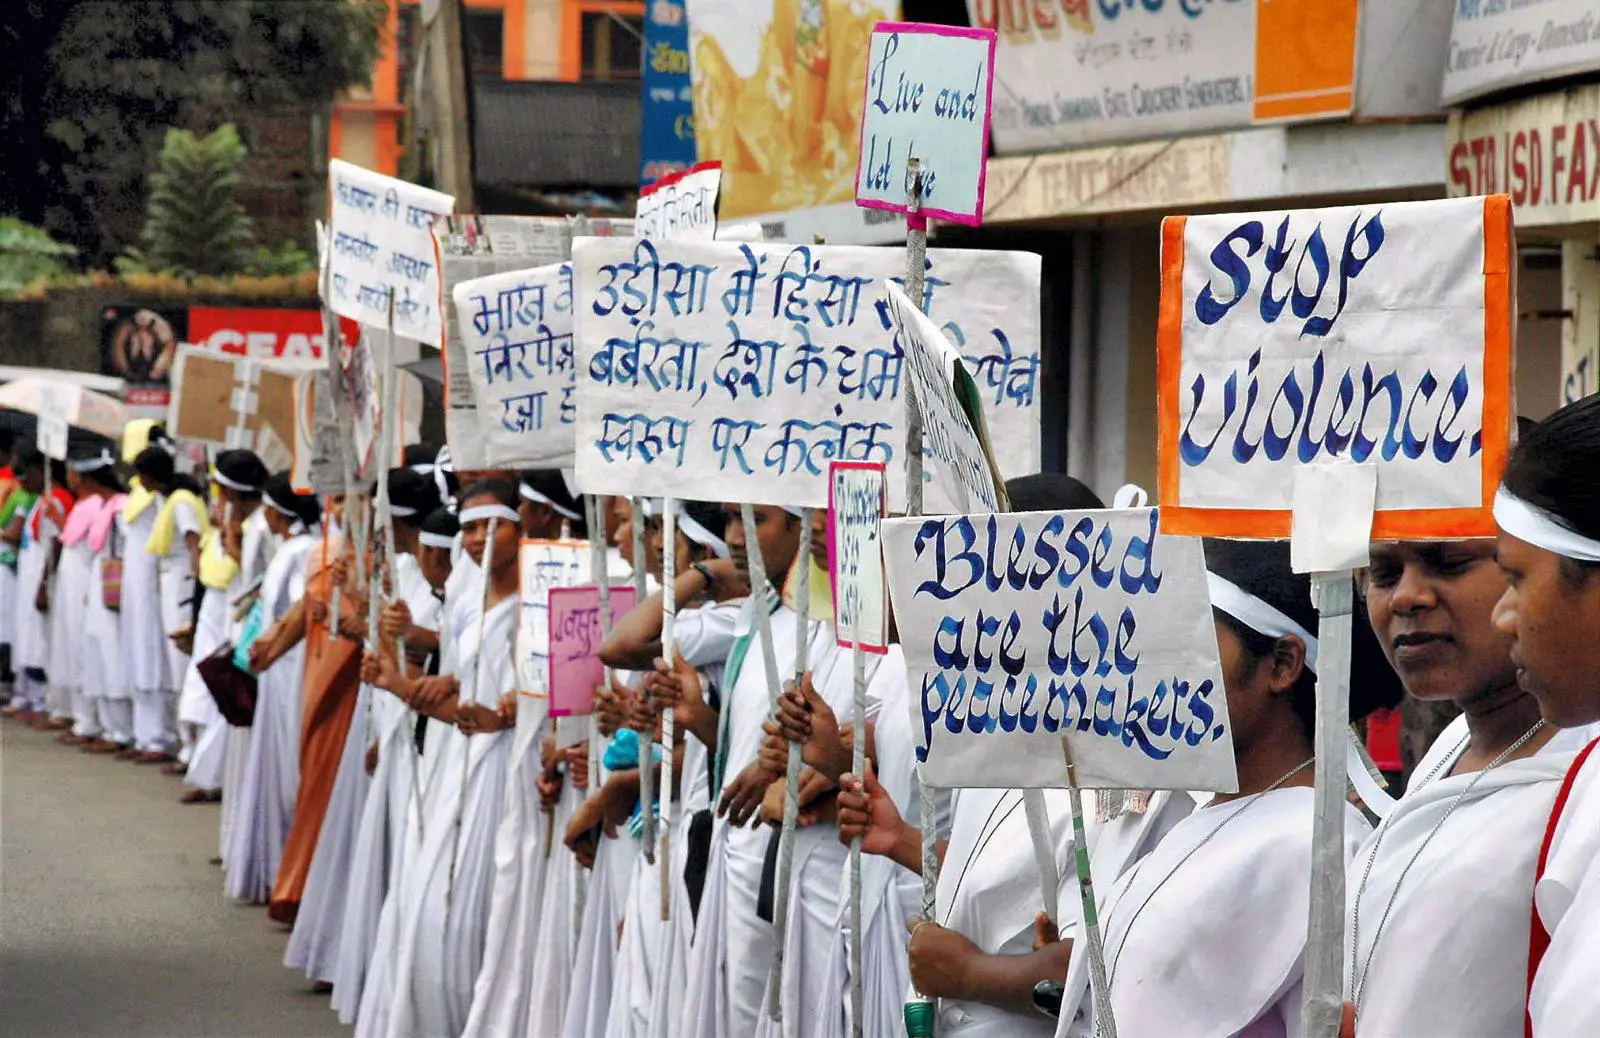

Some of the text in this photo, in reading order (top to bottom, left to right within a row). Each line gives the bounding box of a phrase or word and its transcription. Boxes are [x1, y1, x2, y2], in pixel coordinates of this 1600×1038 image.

[871, 32, 924, 115] Live
[934, 61, 983, 122] and
[866, 133, 893, 192] let
[904, 140, 936, 198] lve
[721, 243, 768, 317] में
[773, 246, 875, 328] हिंसा
[913, 508, 1164, 600] Blessed
[932, 585, 1141, 678] are the
[915, 670, 1226, 763] peacemakers.
